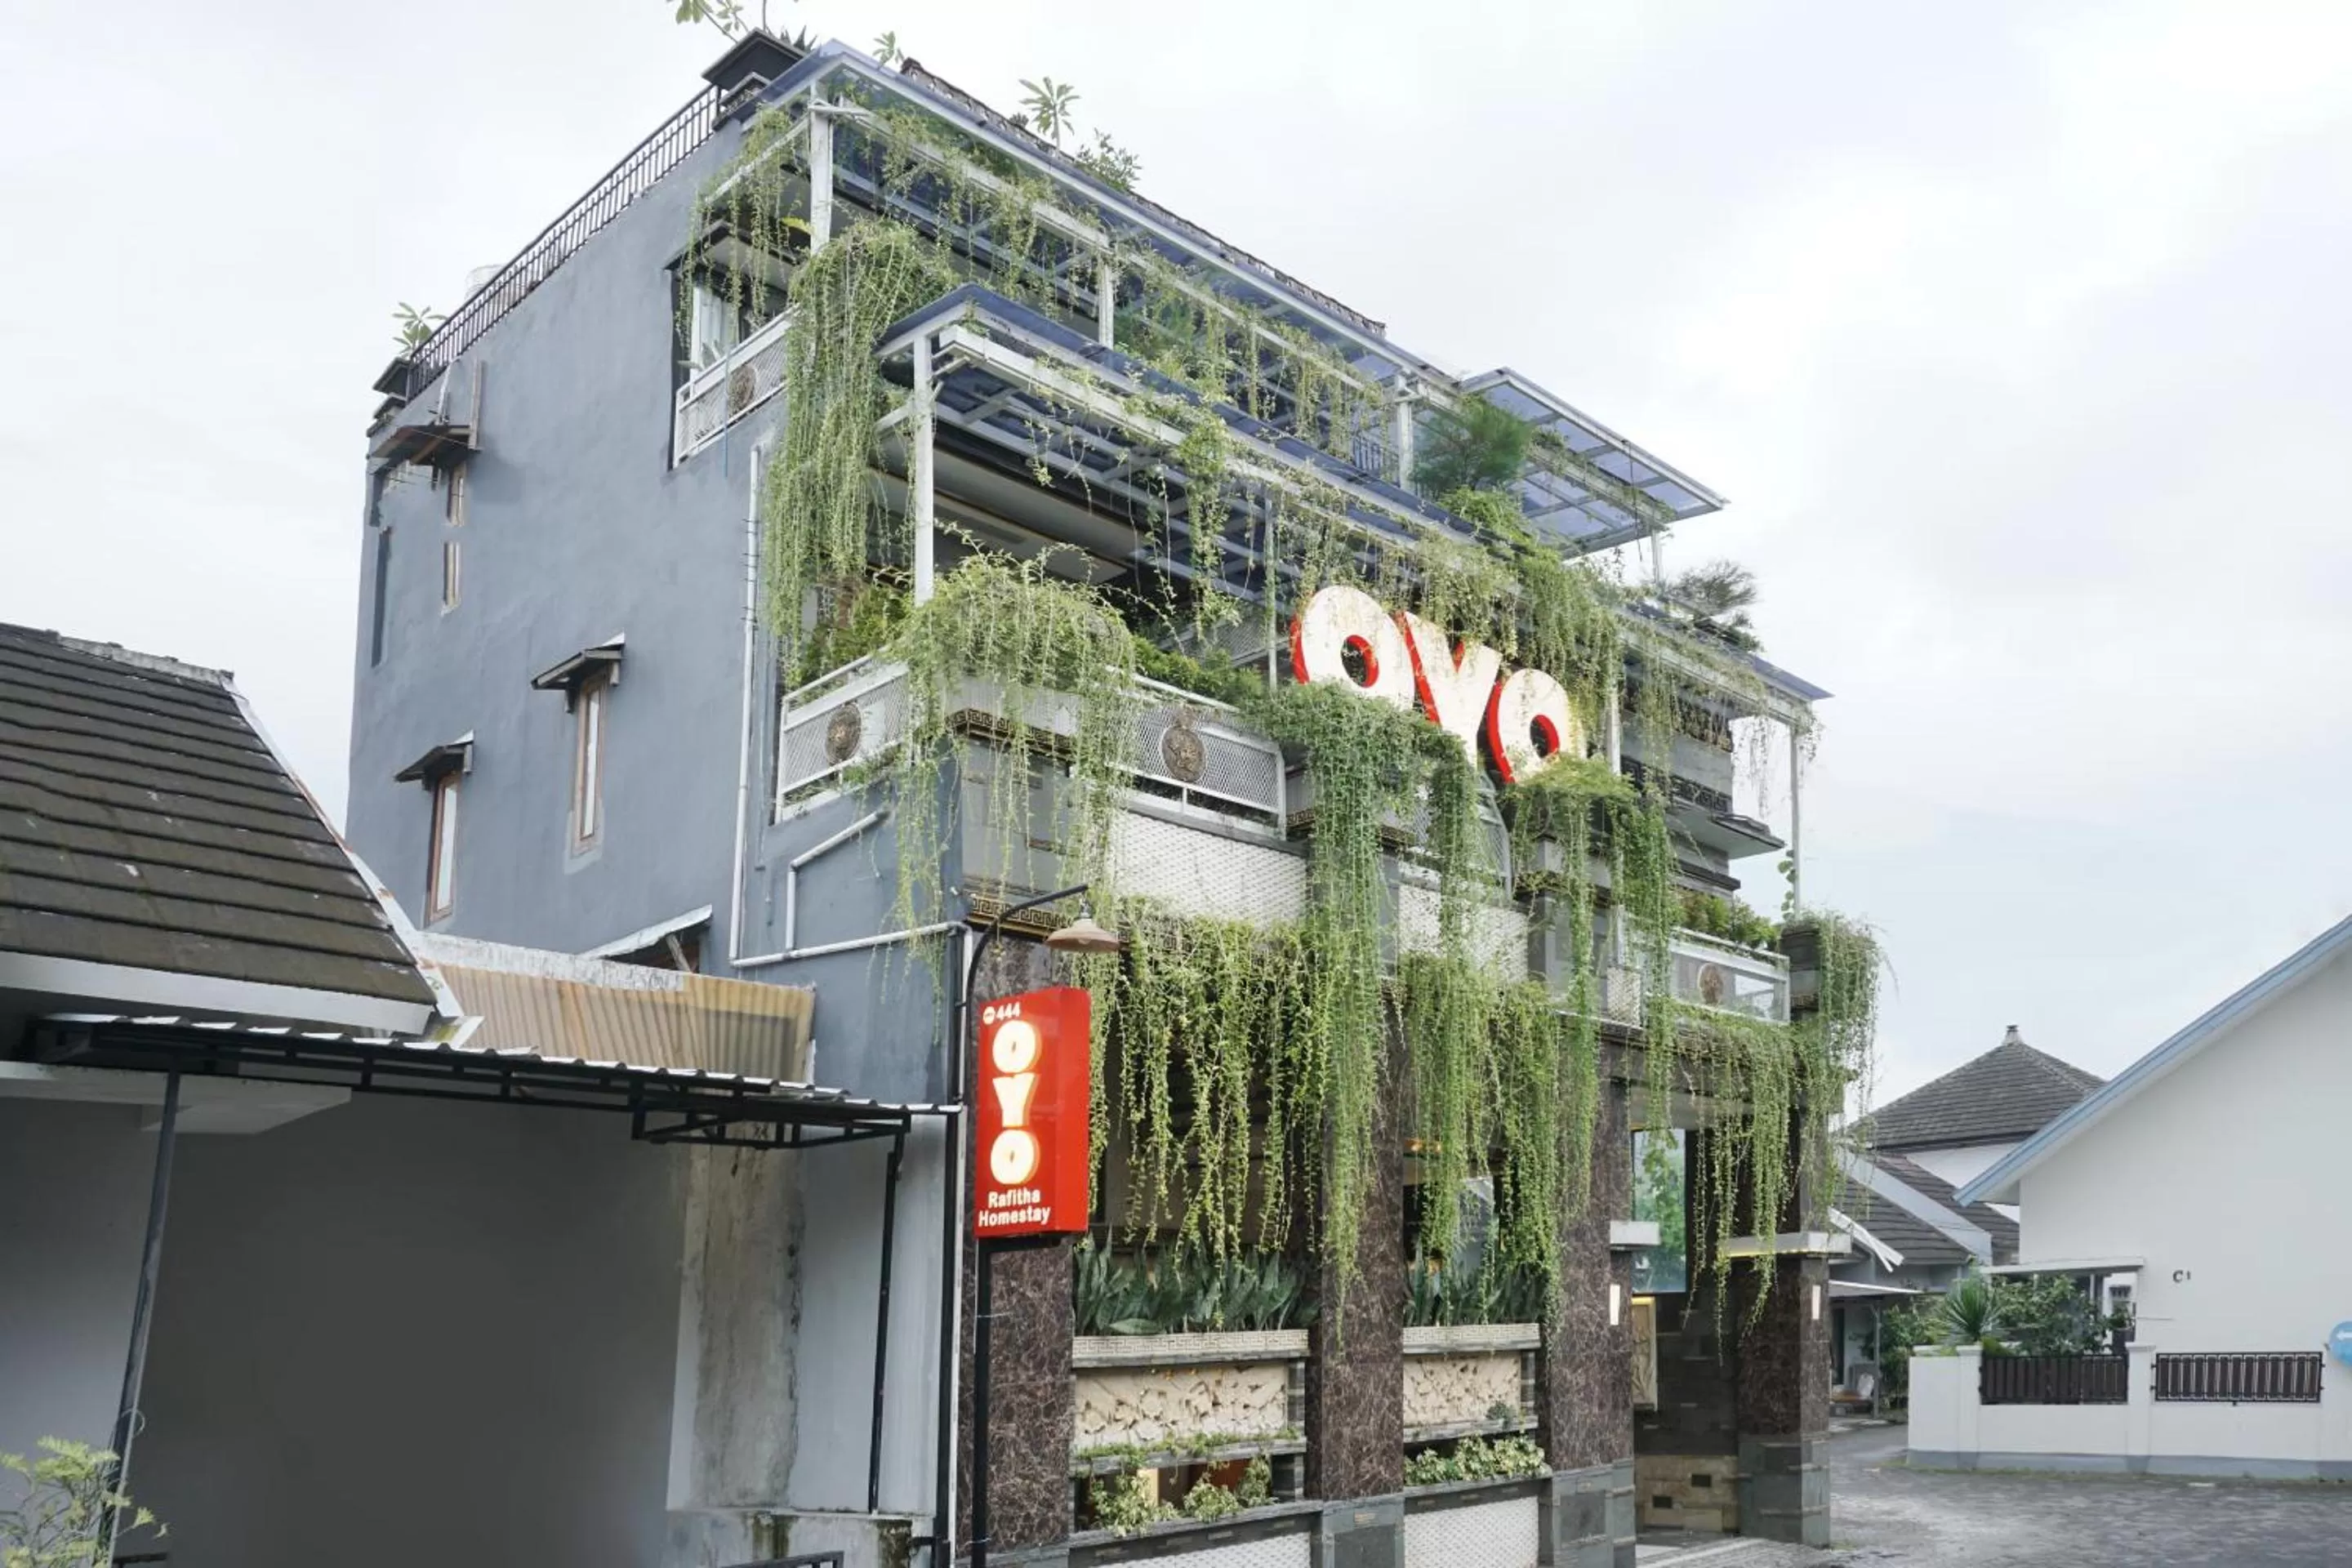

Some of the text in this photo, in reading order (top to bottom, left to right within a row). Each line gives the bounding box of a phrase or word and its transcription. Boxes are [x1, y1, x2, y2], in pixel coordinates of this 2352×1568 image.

[1290, 585, 1587, 784] OYO
[996, 1001, 1021, 1020] 444
[990, 1020, 1041, 1184] OYO
[988, 1187, 1041, 1209] Rafitha
[978, 1205, 1052, 1227] Homestay
